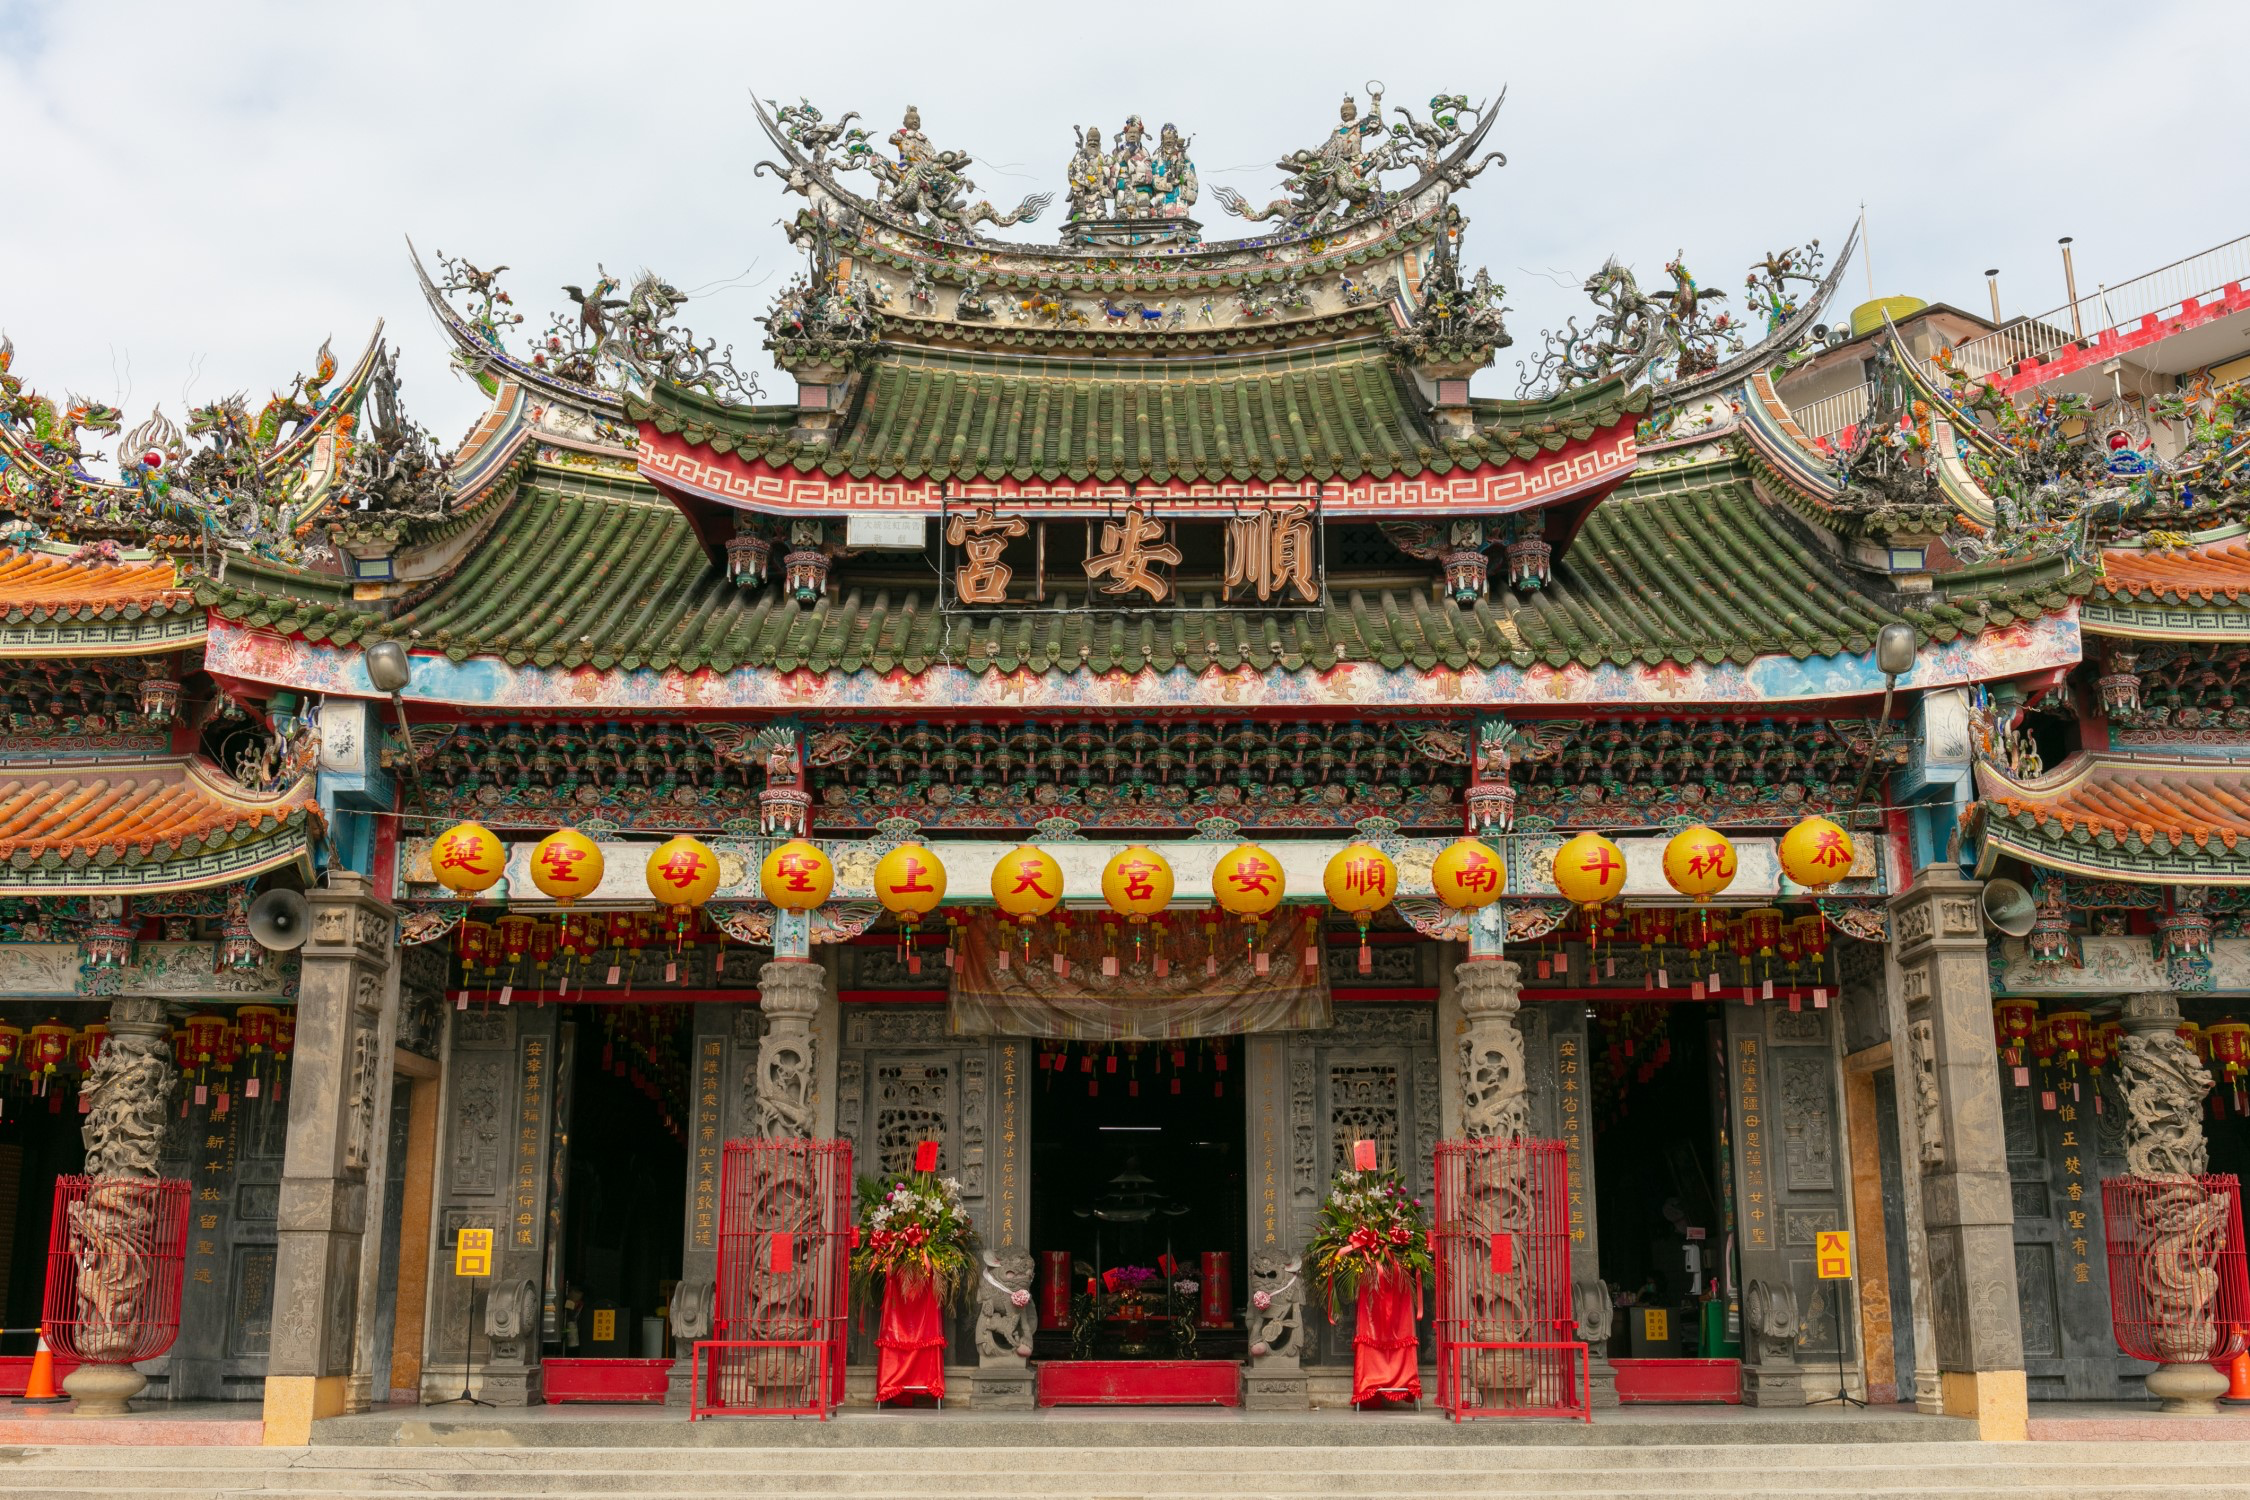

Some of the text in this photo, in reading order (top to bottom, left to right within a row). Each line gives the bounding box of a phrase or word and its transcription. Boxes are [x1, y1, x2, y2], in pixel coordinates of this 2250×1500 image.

[946, 504, 1320, 604] 順安宮
[441, 843, 490, 875] 誕
[540, 842, 587, 882] 聖
[1580, 846, 1620, 885] 斗
[1688, 843, 1734, 880] 祝
[1811, 829, 1852, 868] 恭
[657, 851, 705, 889] 母
[777, 853, 821, 892] 聖
[889, 857, 934, 894] 上
[1011, 860, 1054, 899] 天
[1118, 860, 1162, 901] 宮
[1229, 856, 1277, 897] 安
[1346, 856, 1385, 898] 順
[1455, 850, 1498, 893] 南
[461, 1231, 488, 1274] 出口
[1821, 1234, 1846, 1276] 入口
